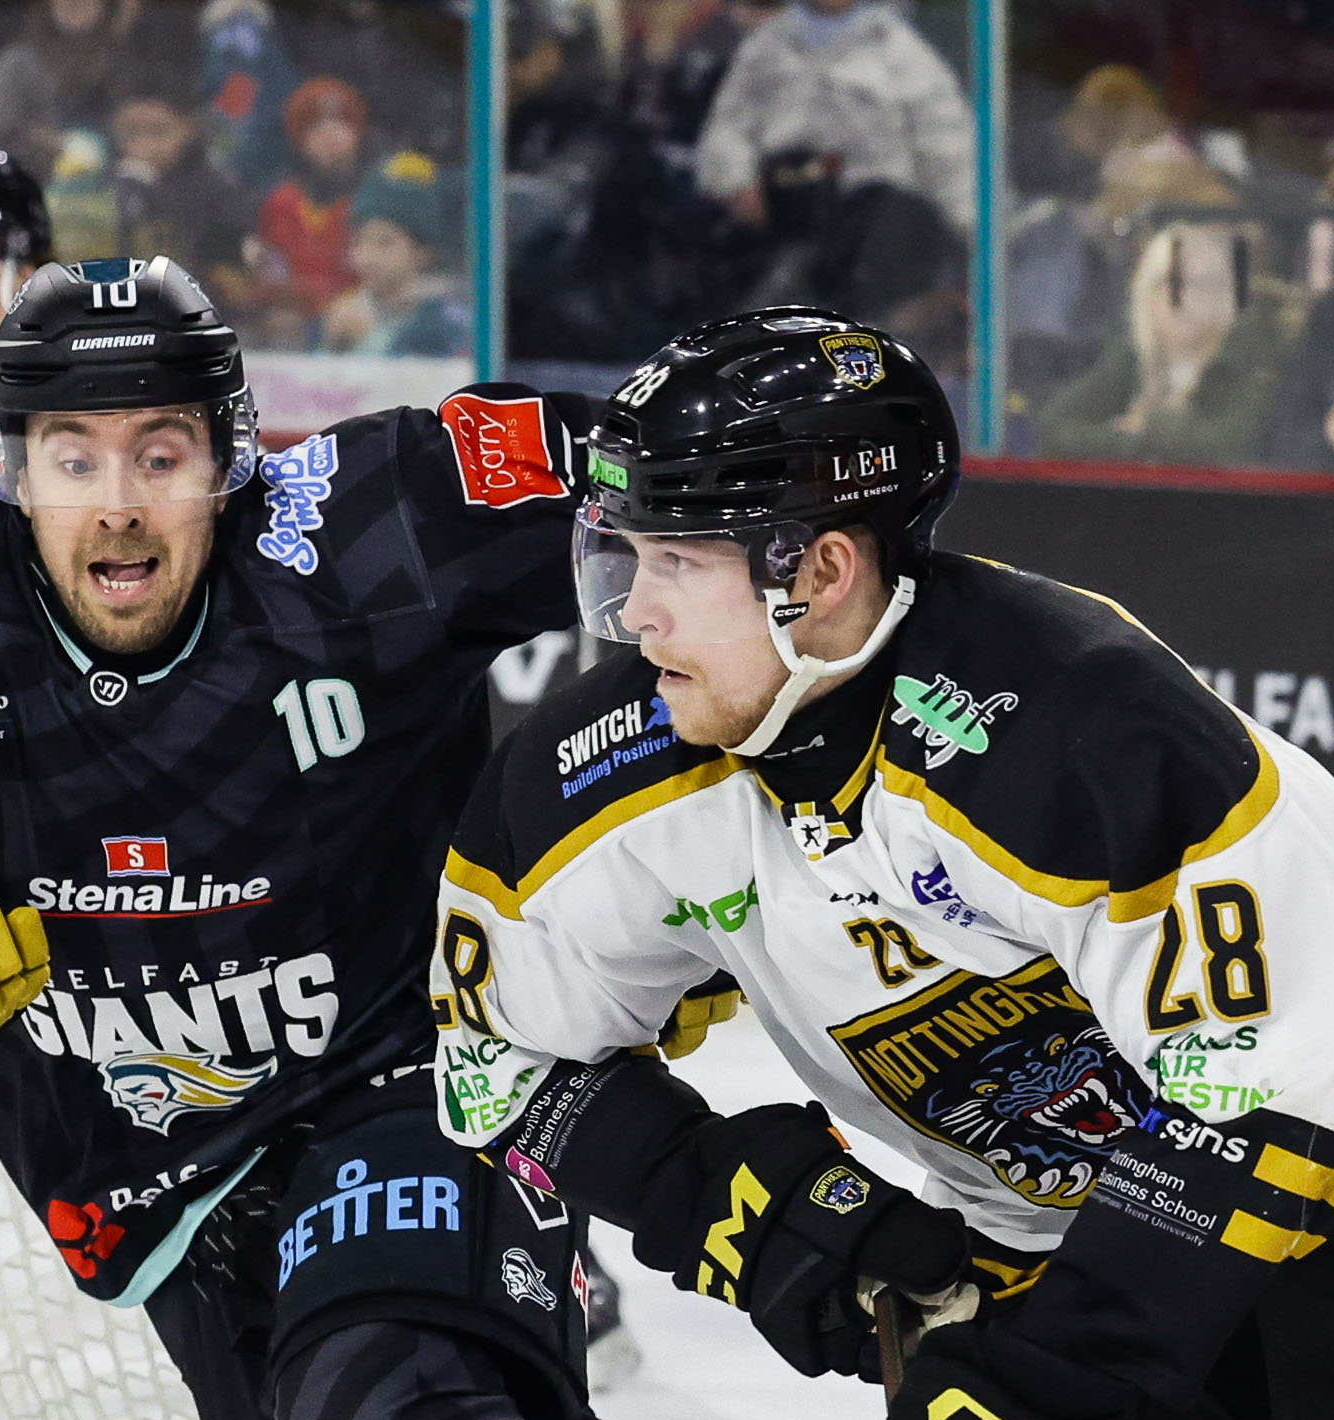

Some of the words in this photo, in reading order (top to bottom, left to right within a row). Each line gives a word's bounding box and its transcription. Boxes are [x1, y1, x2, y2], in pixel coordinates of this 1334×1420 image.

[93, 280, 137, 308] 10
[71, 334, 156, 351] WARRIOR
[614, 362, 670, 408] 28
[834, 491, 859, 502] LAKE
[864, 484, 899, 497] ENERGY
[774, 605, 807, 618] CCM
[272, 678, 366, 773] 10
[556, 700, 643, 775] SWITCH
[561, 759, 612, 799] Building
[612, 735, 670, 768] Positive
[127, 844, 145, 868] S
[44, 956, 278, 990] ELFAST
[1145, 879, 1271, 1035] 28
[1167, 1081, 1283, 1112] ESTIN
[530, 1091, 573, 1162] Business
[1151, 1191, 1217, 1230] School
[279, 1175, 460, 1293] BETTER
